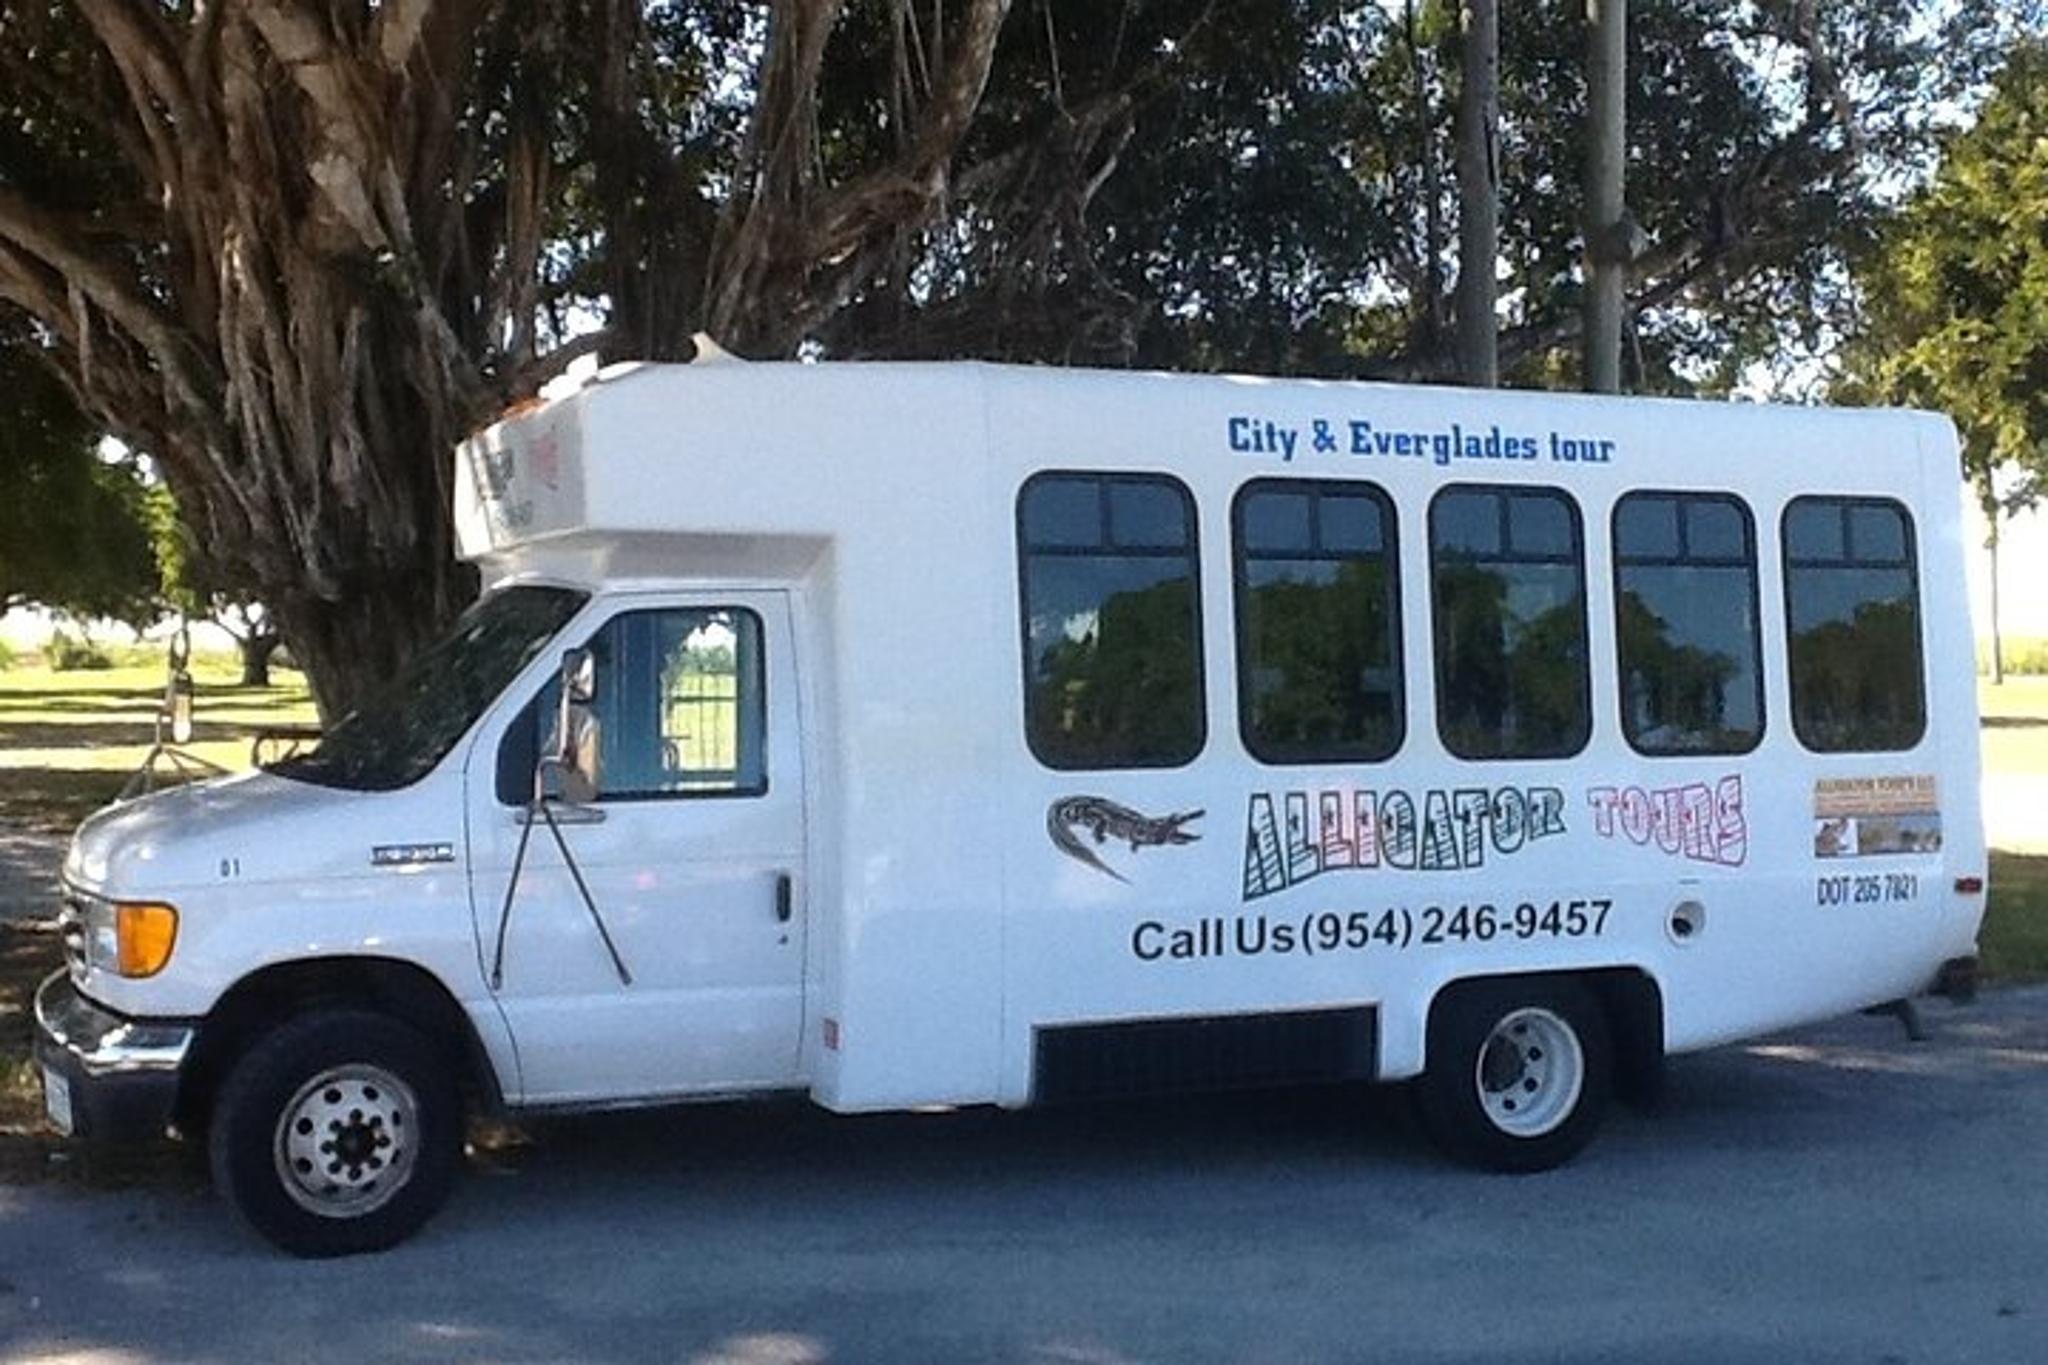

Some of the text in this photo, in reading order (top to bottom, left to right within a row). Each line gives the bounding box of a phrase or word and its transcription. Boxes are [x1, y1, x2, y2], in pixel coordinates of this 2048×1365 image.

[1228, 417, 1616, 465] City & Everglades tour
[1243, 774, 1747, 901] ALLIGATOR TOURS
[1818, 875, 1850, 906] DOT
[1132, 899, 1614, 961] Call Us (954) 246-9457
